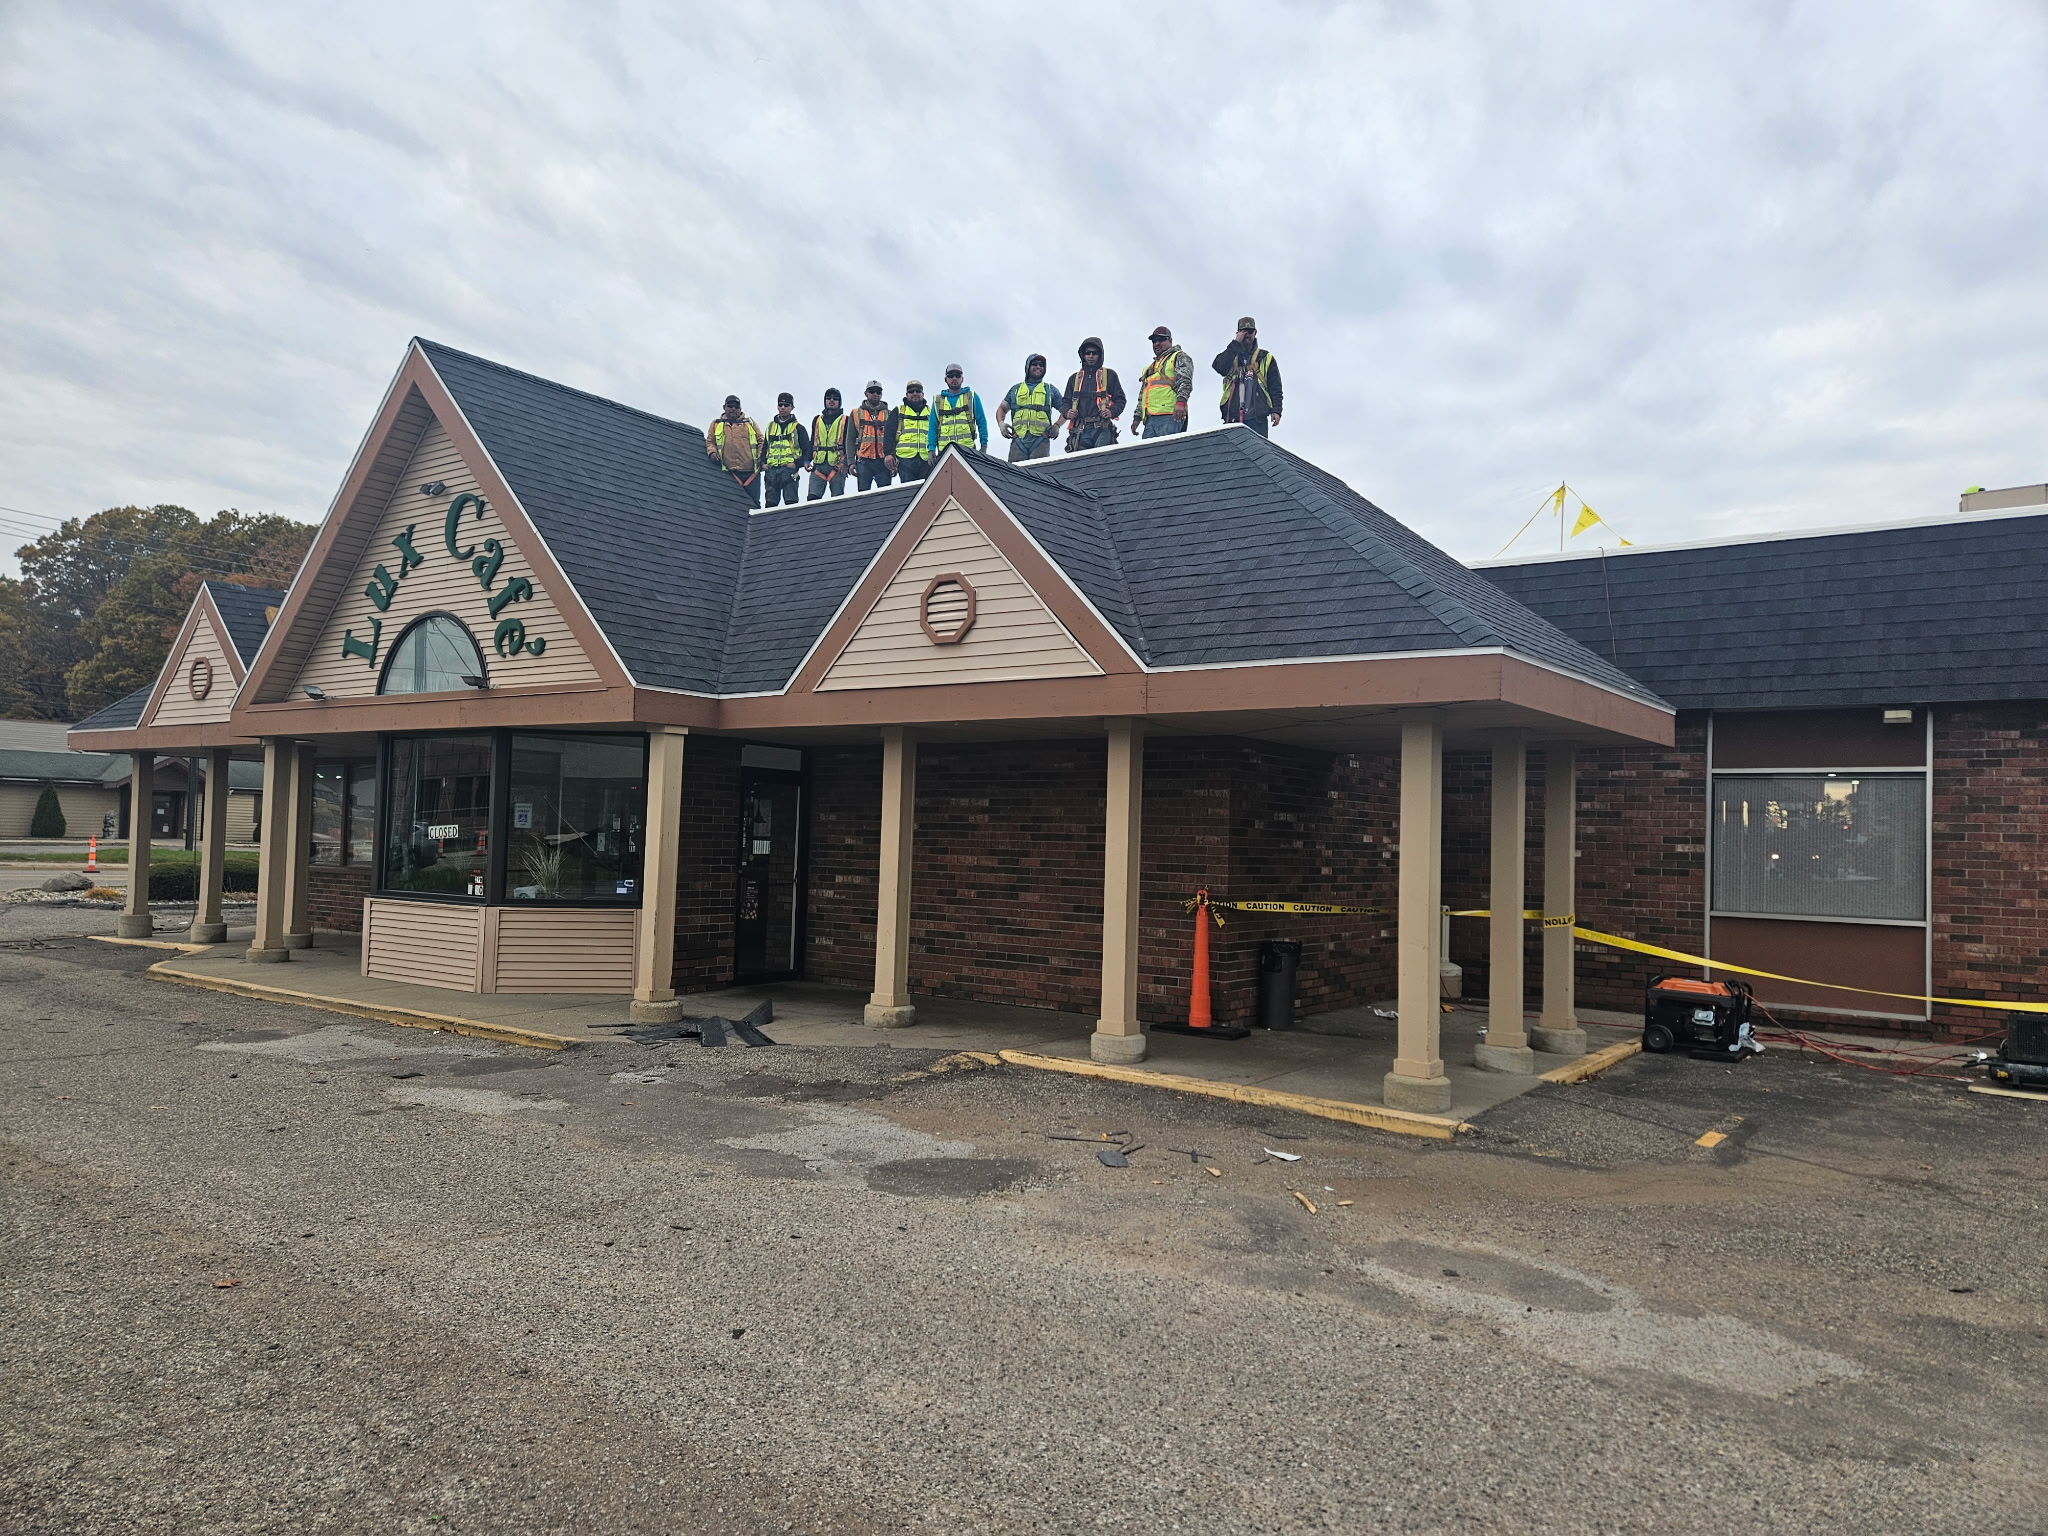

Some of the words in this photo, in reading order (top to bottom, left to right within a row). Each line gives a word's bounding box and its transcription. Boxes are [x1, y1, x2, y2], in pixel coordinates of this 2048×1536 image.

[342, 524, 424, 669] Lux
[430, 826, 457, 838] CLOSED
[1246, 902, 1285, 911] CAUTION
[1293, 904, 1333, 913] CAUTION
